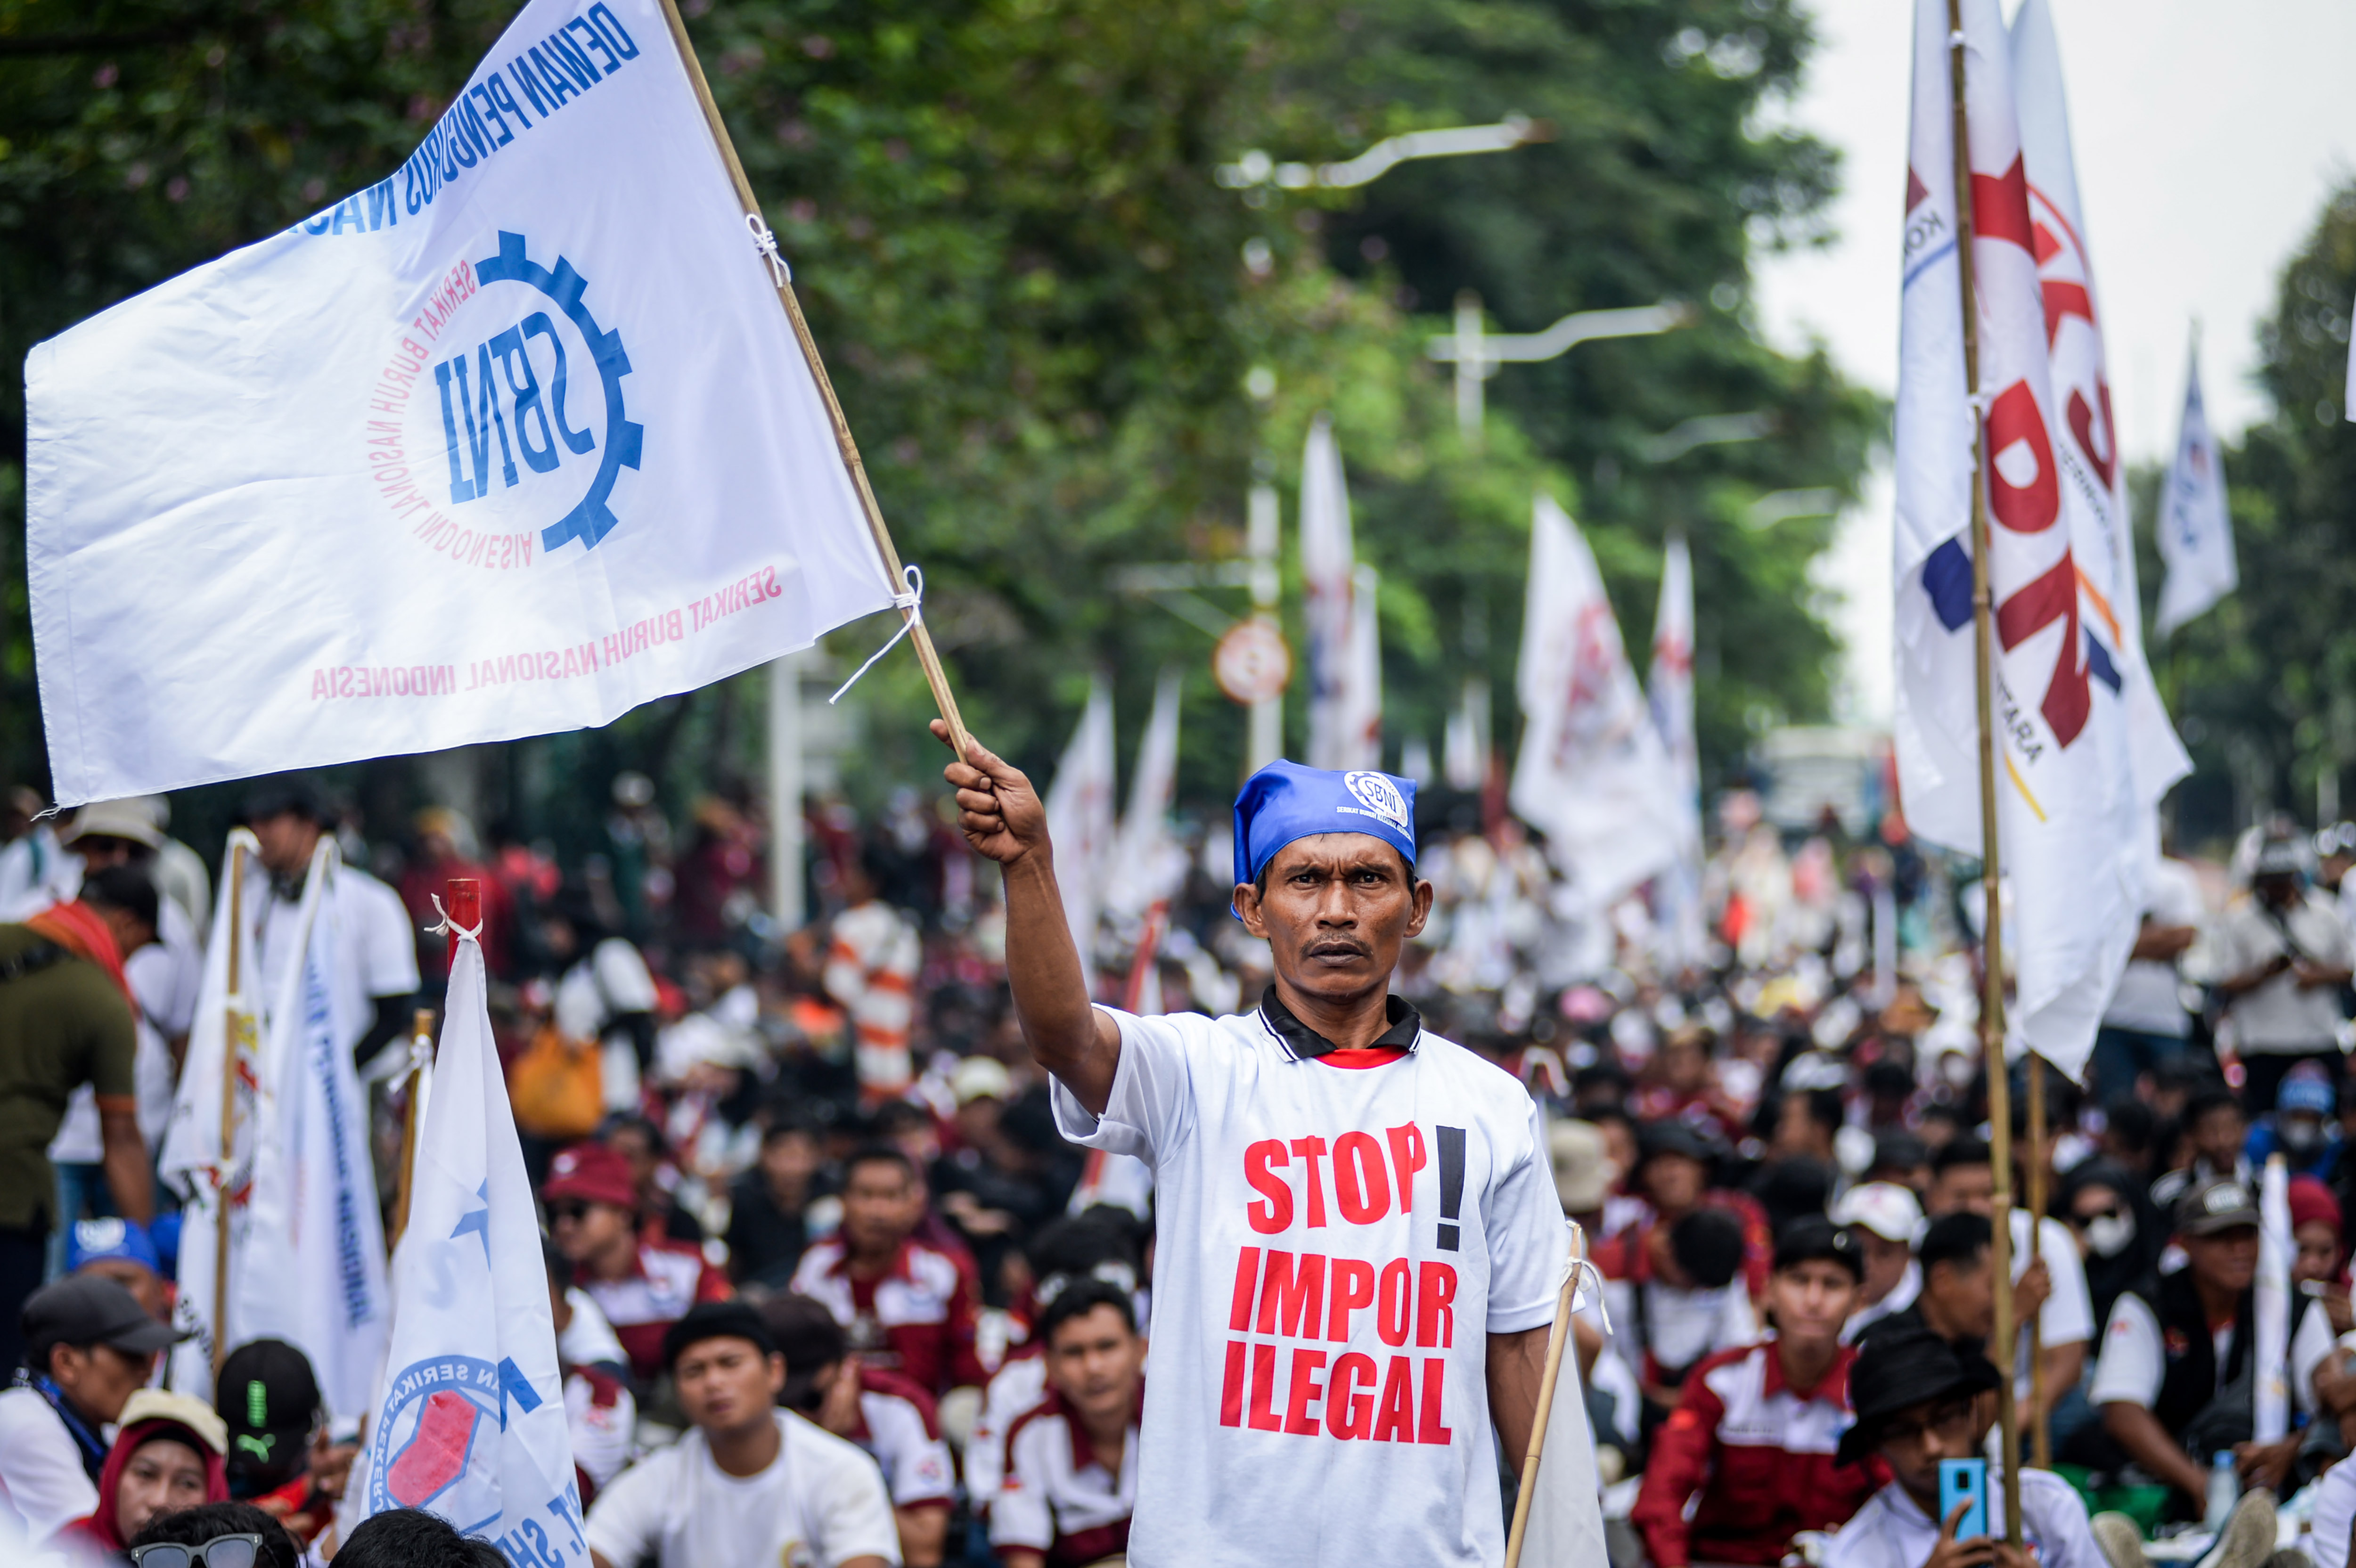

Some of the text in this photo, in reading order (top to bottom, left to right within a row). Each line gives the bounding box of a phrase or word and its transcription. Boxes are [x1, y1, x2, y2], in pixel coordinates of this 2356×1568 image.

[1336, 806, 1359, 815] SERIKAT
[1359, 808, 1377, 820] BURUH
[1365, 780, 1397, 814] SBNI
[1243, 1120, 1466, 1252] STOP!
[1229, 1246, 1457, 1349] IMPOR
[1220, 1340, 1452, 1445] ILEGAL
